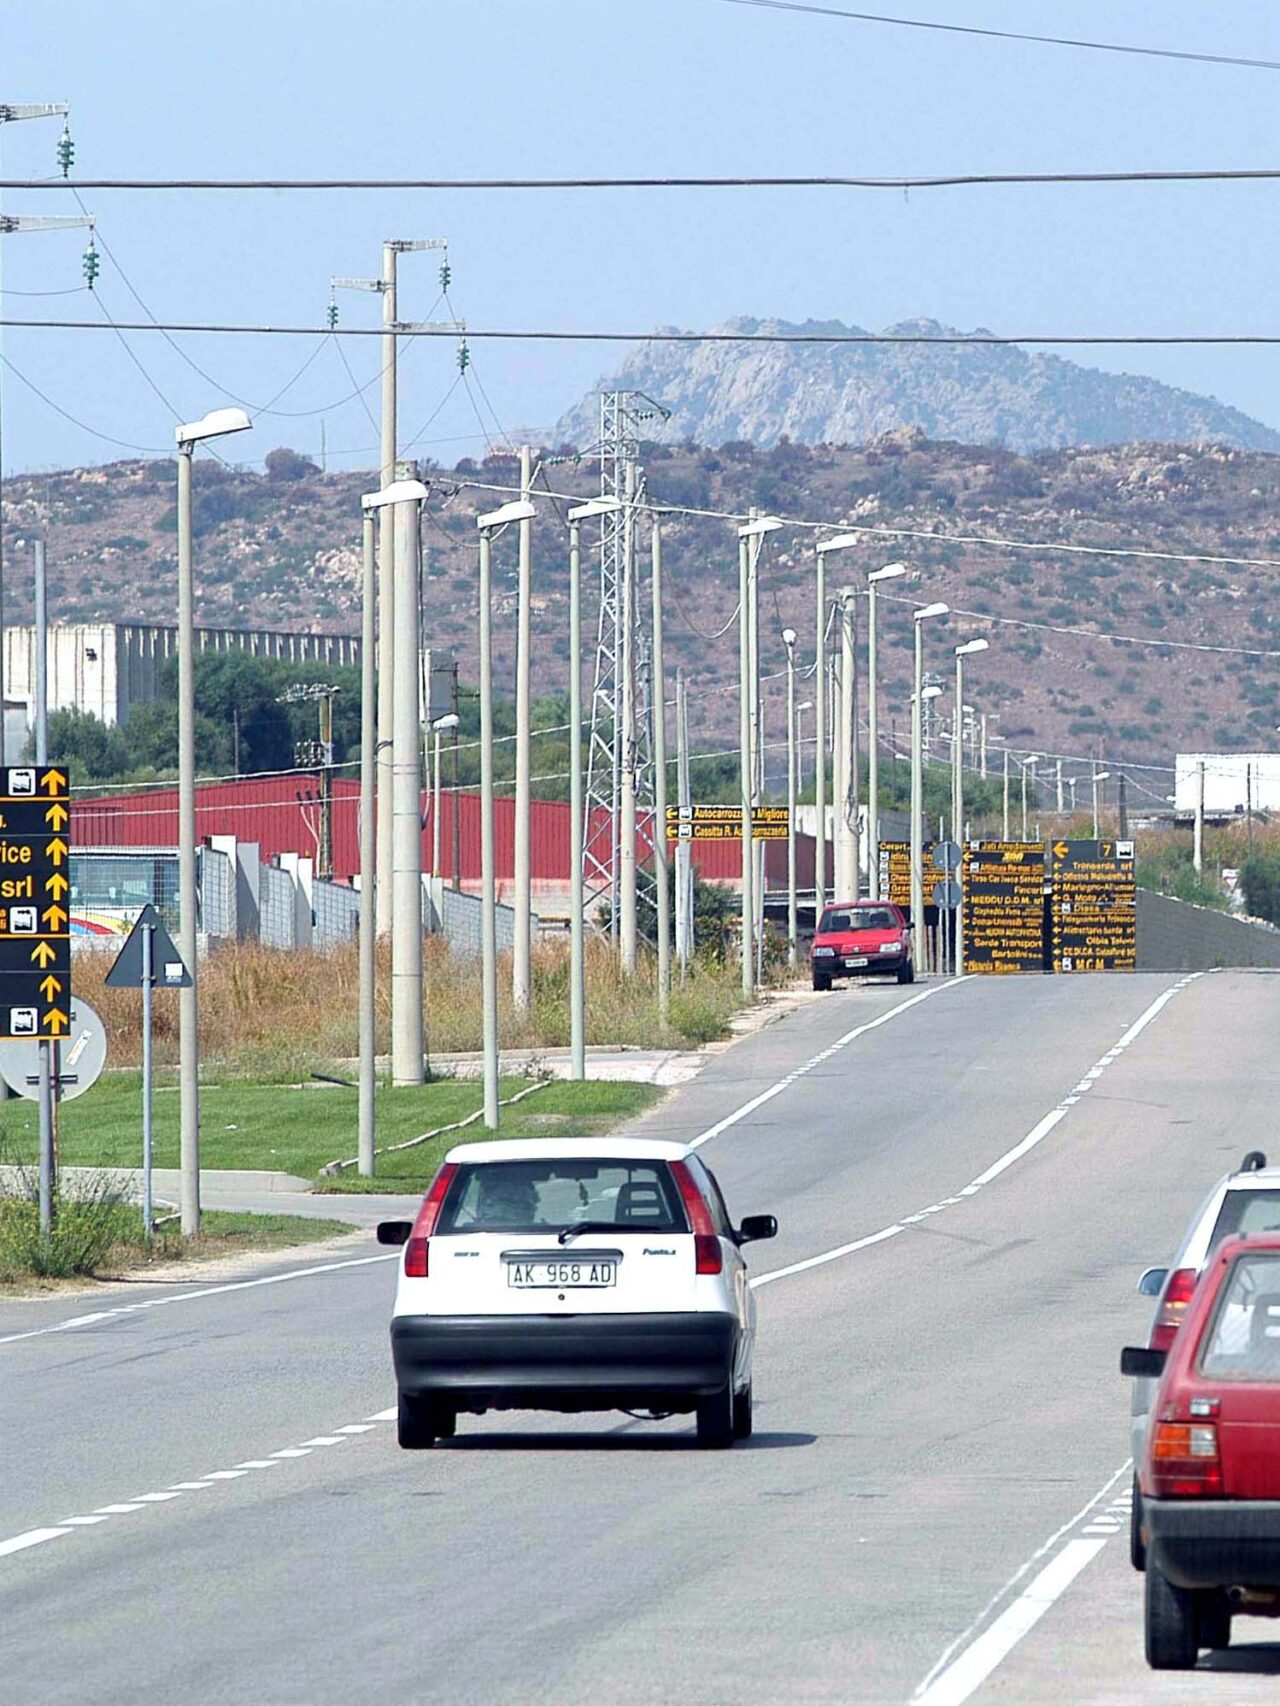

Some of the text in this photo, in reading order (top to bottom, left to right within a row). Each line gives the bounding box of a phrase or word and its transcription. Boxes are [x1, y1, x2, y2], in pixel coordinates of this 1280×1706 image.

[0, 841, 32, 864] ice
[1102, 844, 1112, 857] 7
[1, 875, 33, 898] srl
[513, 1263, 612, 1283] AK 968 AD
